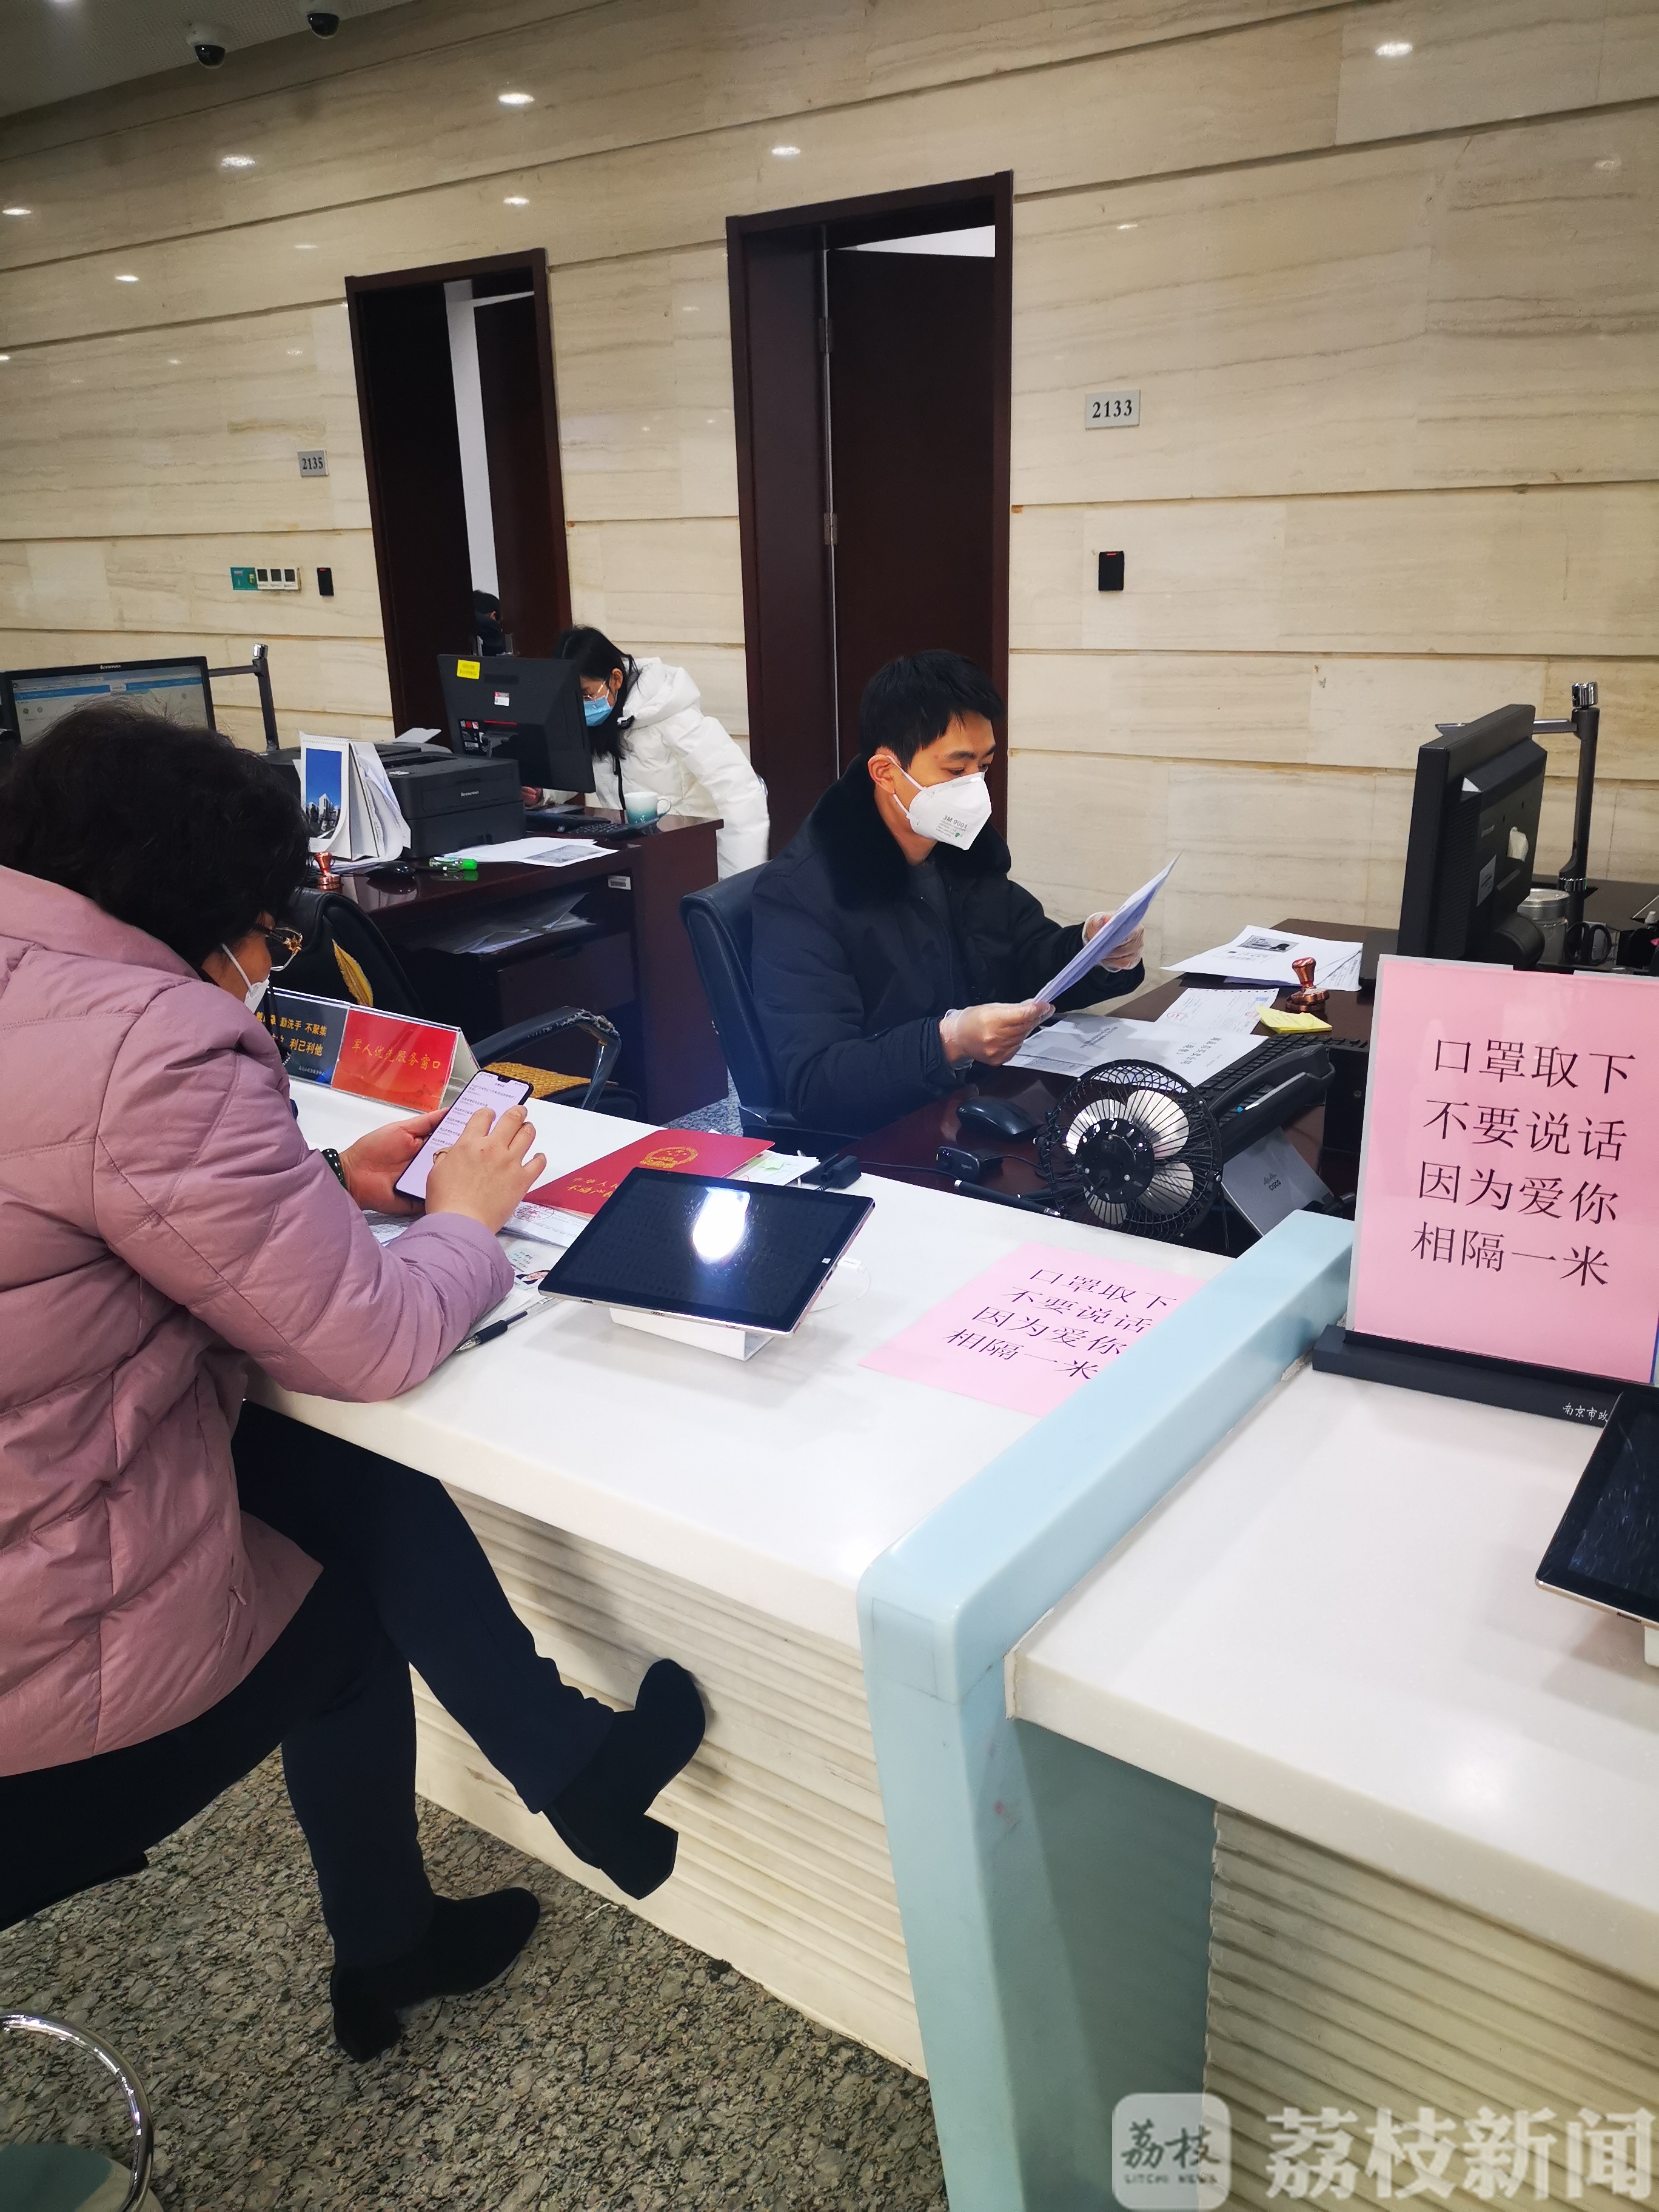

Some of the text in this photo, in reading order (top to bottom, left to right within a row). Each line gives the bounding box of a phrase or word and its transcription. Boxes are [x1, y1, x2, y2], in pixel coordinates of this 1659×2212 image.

[1092, 399, 1133, 418] 2133
[302, 457, 324, 470] 2135
[943, 814, 968, 829] 3M 9001
[289, 1038, 323, 1056] 利己利他
[304, 1022, 327, 1037] 不聚集
[352, 1038, 441, 1071] 军人优先服务窗口
[1435, 1039, 1636, 1094] 口罩取下
[1423, 1099, 1626, 1162] 不要说话
[1419, 1161, 1620, 1225] 因为爱你
[1410, 1221, 1610, 1286] 相隔一米
[1030, 1269, 1178, 1309] 口罩取下
[1002, 1286, 1153, 1333] 不要说话
[971, 1306, 1128, 1355] 因为爱你
[943, 1329, 1099, 1379] 相隔一米
[1563, 1403, 1609, 1423] 南京市政
